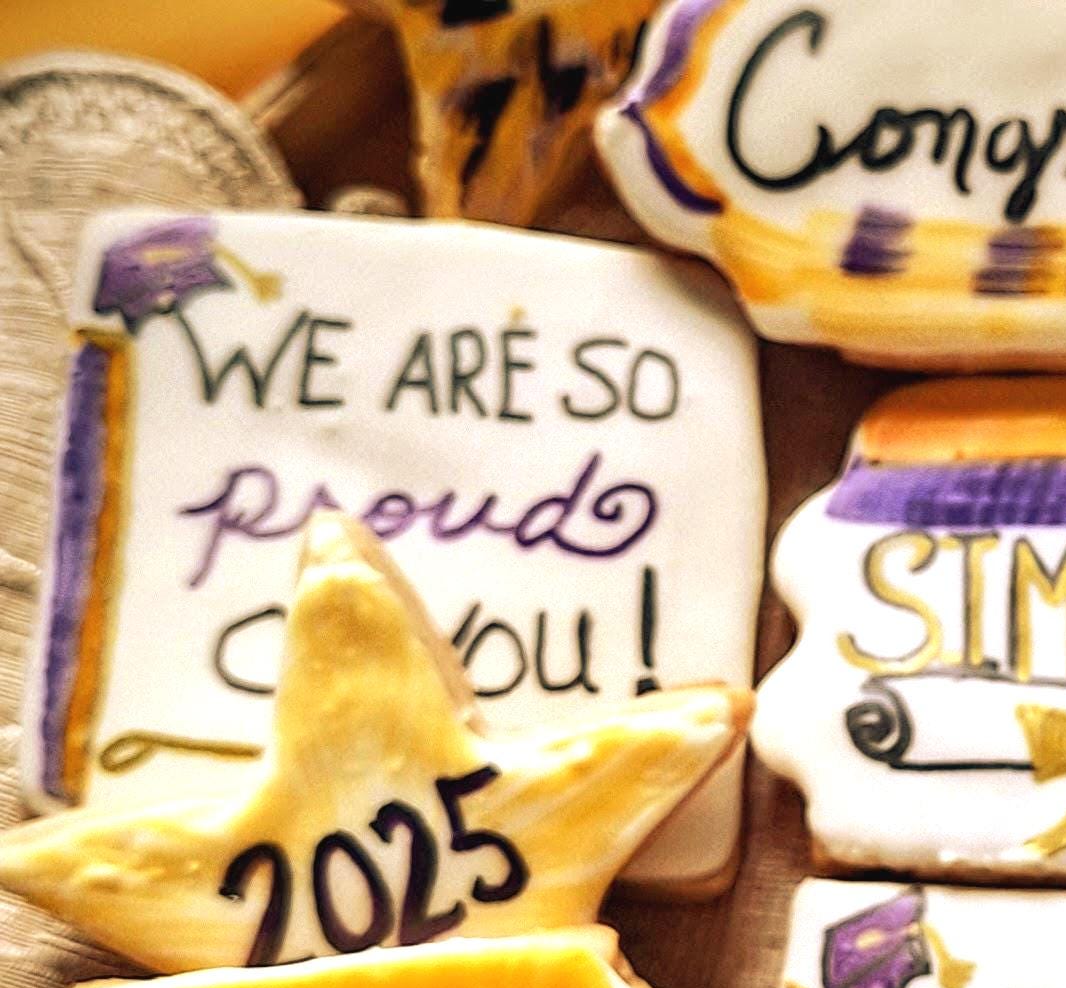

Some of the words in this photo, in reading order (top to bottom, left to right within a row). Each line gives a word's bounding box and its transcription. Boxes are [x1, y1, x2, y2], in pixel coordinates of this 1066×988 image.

[172, 306, 355, 412] WE
[386, 322, 535, 421] ARE
[560, 336, 679, 422] SO
[218, 764, 531, 968] 2025
